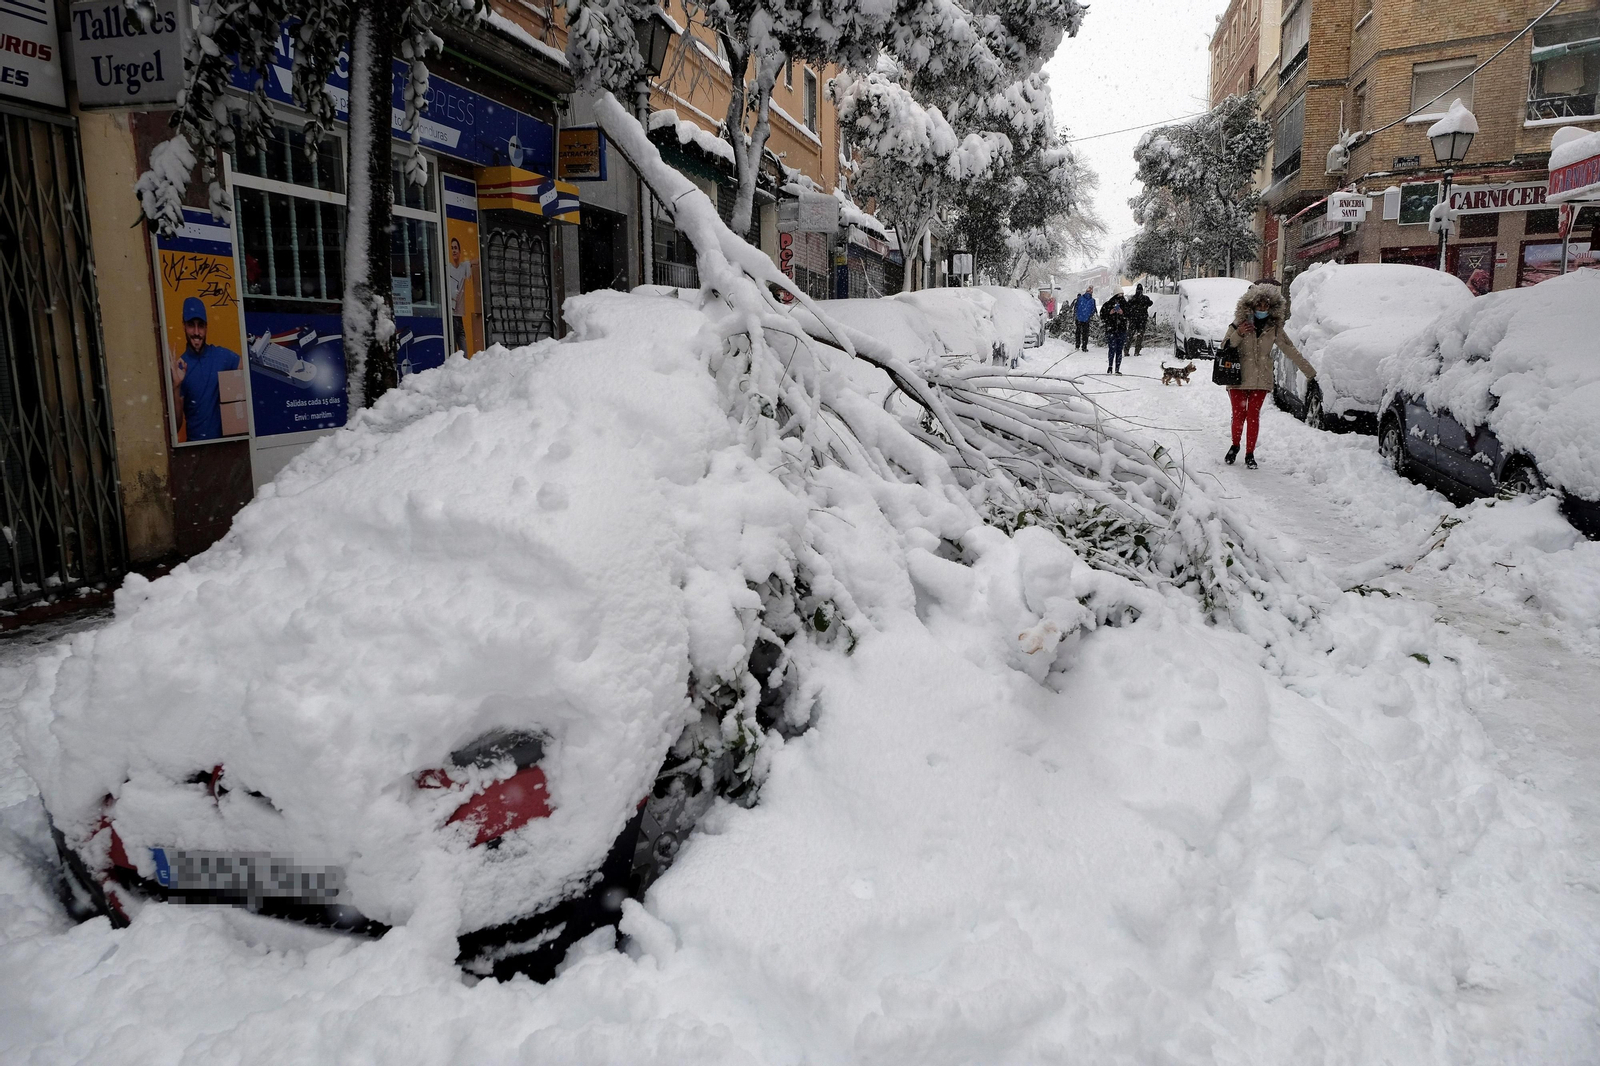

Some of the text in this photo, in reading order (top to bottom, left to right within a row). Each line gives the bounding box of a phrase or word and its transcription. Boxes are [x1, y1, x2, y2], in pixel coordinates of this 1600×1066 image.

[91, 50, 165, 96] Urgel
[1342, 208, 1358, 217] SANTI
[286, 399, 307, 408] Salidas
[308, 397, 322, 406] cada
[322, 398, 329, 406] 15
[160, 870, 169, 879] E
